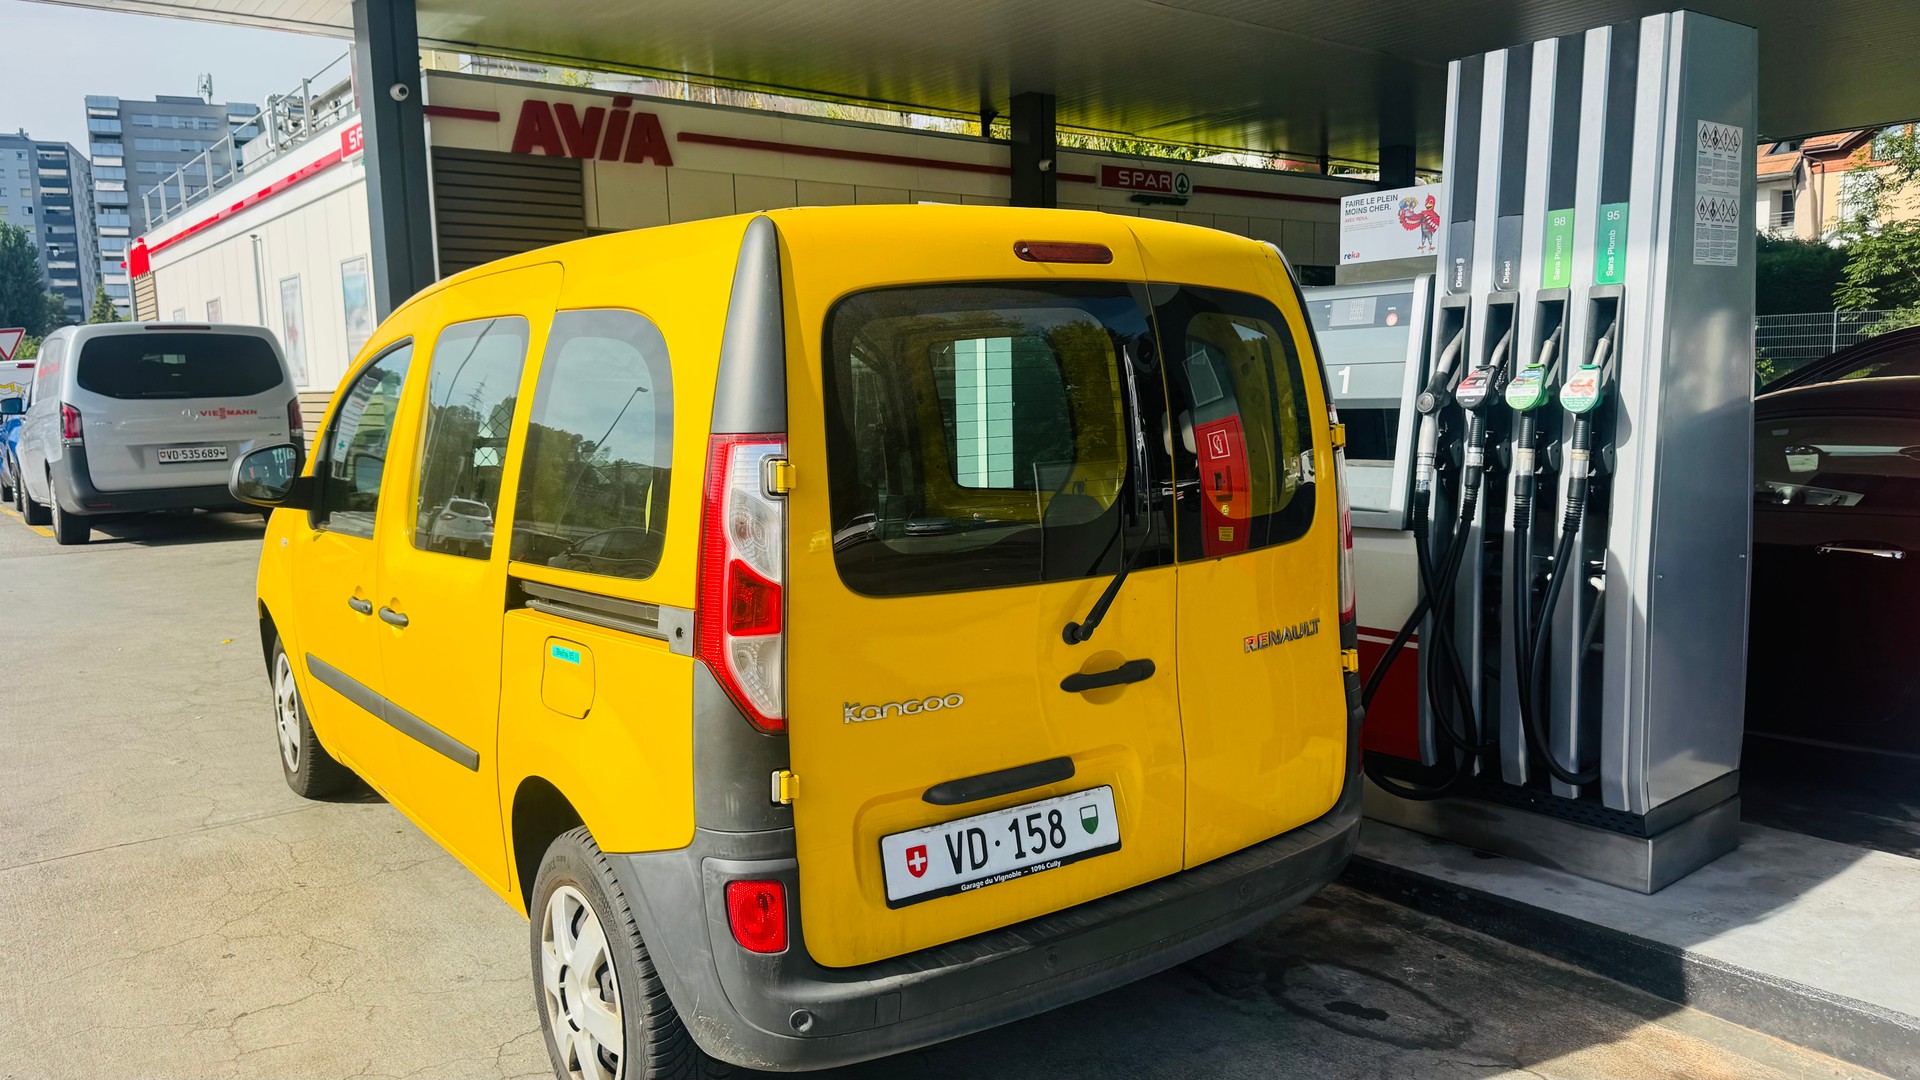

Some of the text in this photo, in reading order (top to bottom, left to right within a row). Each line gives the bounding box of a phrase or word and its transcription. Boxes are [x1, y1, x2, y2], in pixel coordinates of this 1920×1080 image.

[1118, 170, 1171, 189] SPAR
[1345, 194, 1398, 208] FAIRE LE PLEIN
[1345, 203, 1391, 216] MOINS CHER.
[1553, 217, 1566, 226] 98
[1607, 211, 1620, 220] 95
[1344, 251, 1360, 260] reka
[1553, 235, 1562, 280] Sans Plomb
[1606, 229, 1616, 276] Sans Plomb
[1455, 265, 1463, 287] Diesel
[1502, 260, 1510, 284] Diesel
[1338, 365, 1351, 394] 1
[1243, 617, 1320, 654] RENAULT
[843, 693, 964, 724] Kangoo
[961, 881, 984, 891] Garage
[984, 877, 993, 885] du
[993, 870, 1022, 883] Vignoble
[1030, 863, 1046, 873] 1096
[1046, 860, 1062, 868] Cully
